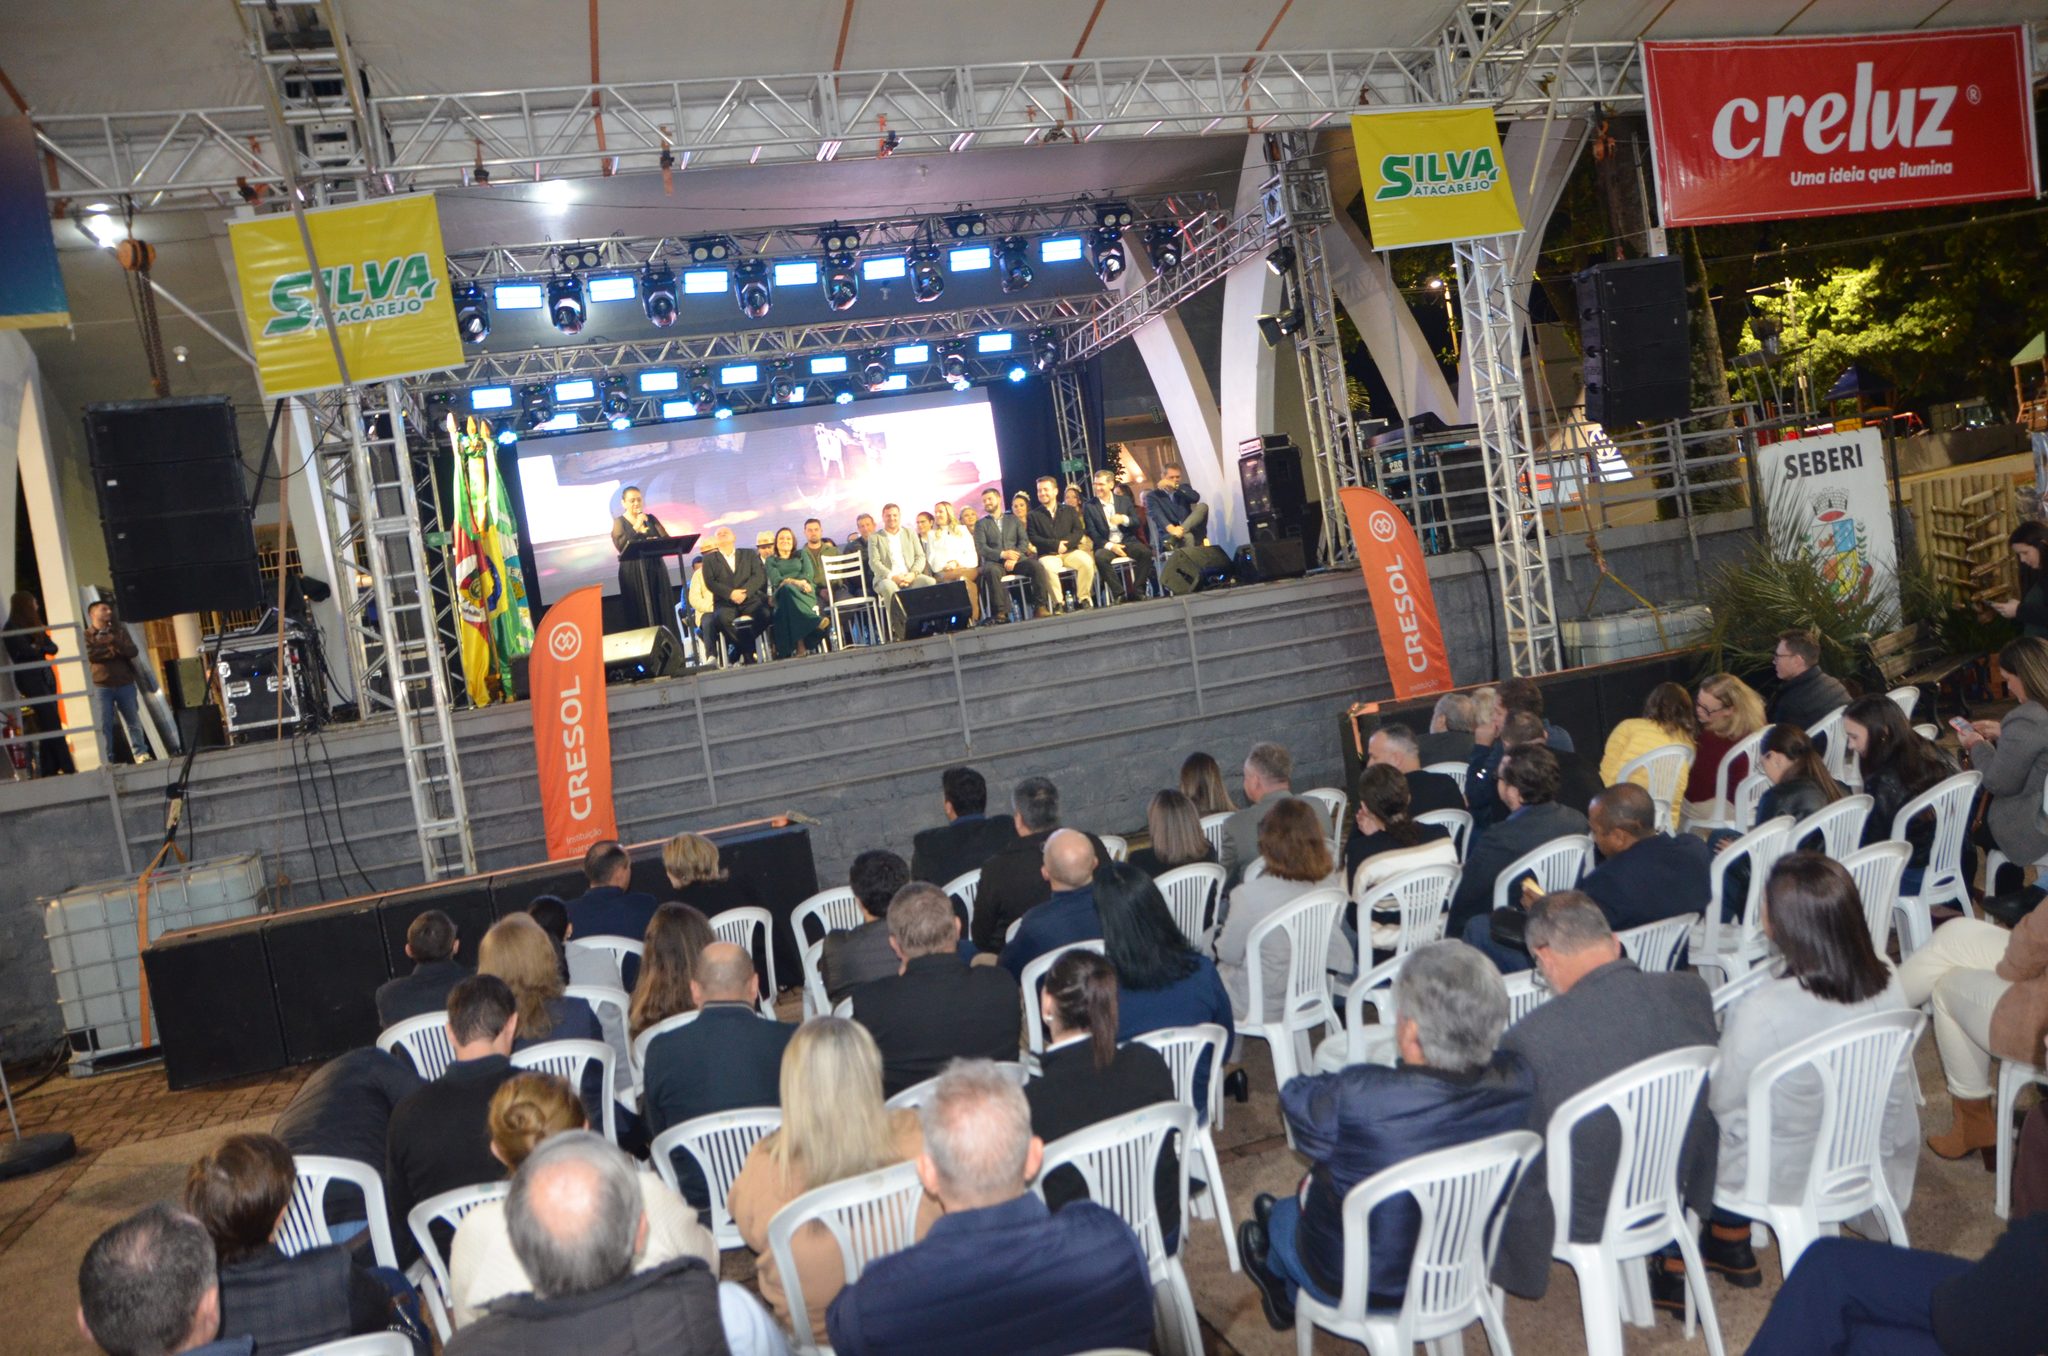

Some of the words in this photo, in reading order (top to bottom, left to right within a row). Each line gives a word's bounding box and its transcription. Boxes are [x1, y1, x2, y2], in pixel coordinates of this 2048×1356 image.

[1712, 61, 1958, 159] creluz
[1376, 148, 1499, 200] SILVA
[1414, 181, 1490, 196] ATACAREJO
[1790, 171, 1826, 187] Uma
[1829, 166, 1866, 183] ideia
[1868, 167, 1896, 183] que
[1899, 159, 1953, 178] ilumina
[314, 299, 422, 327] AACAREJO
[1784, 443, 1863, 480] SEBERI
[1385, 553, 1428, 674] CRESOL
[560, 674, 592, 821] CRESOL
